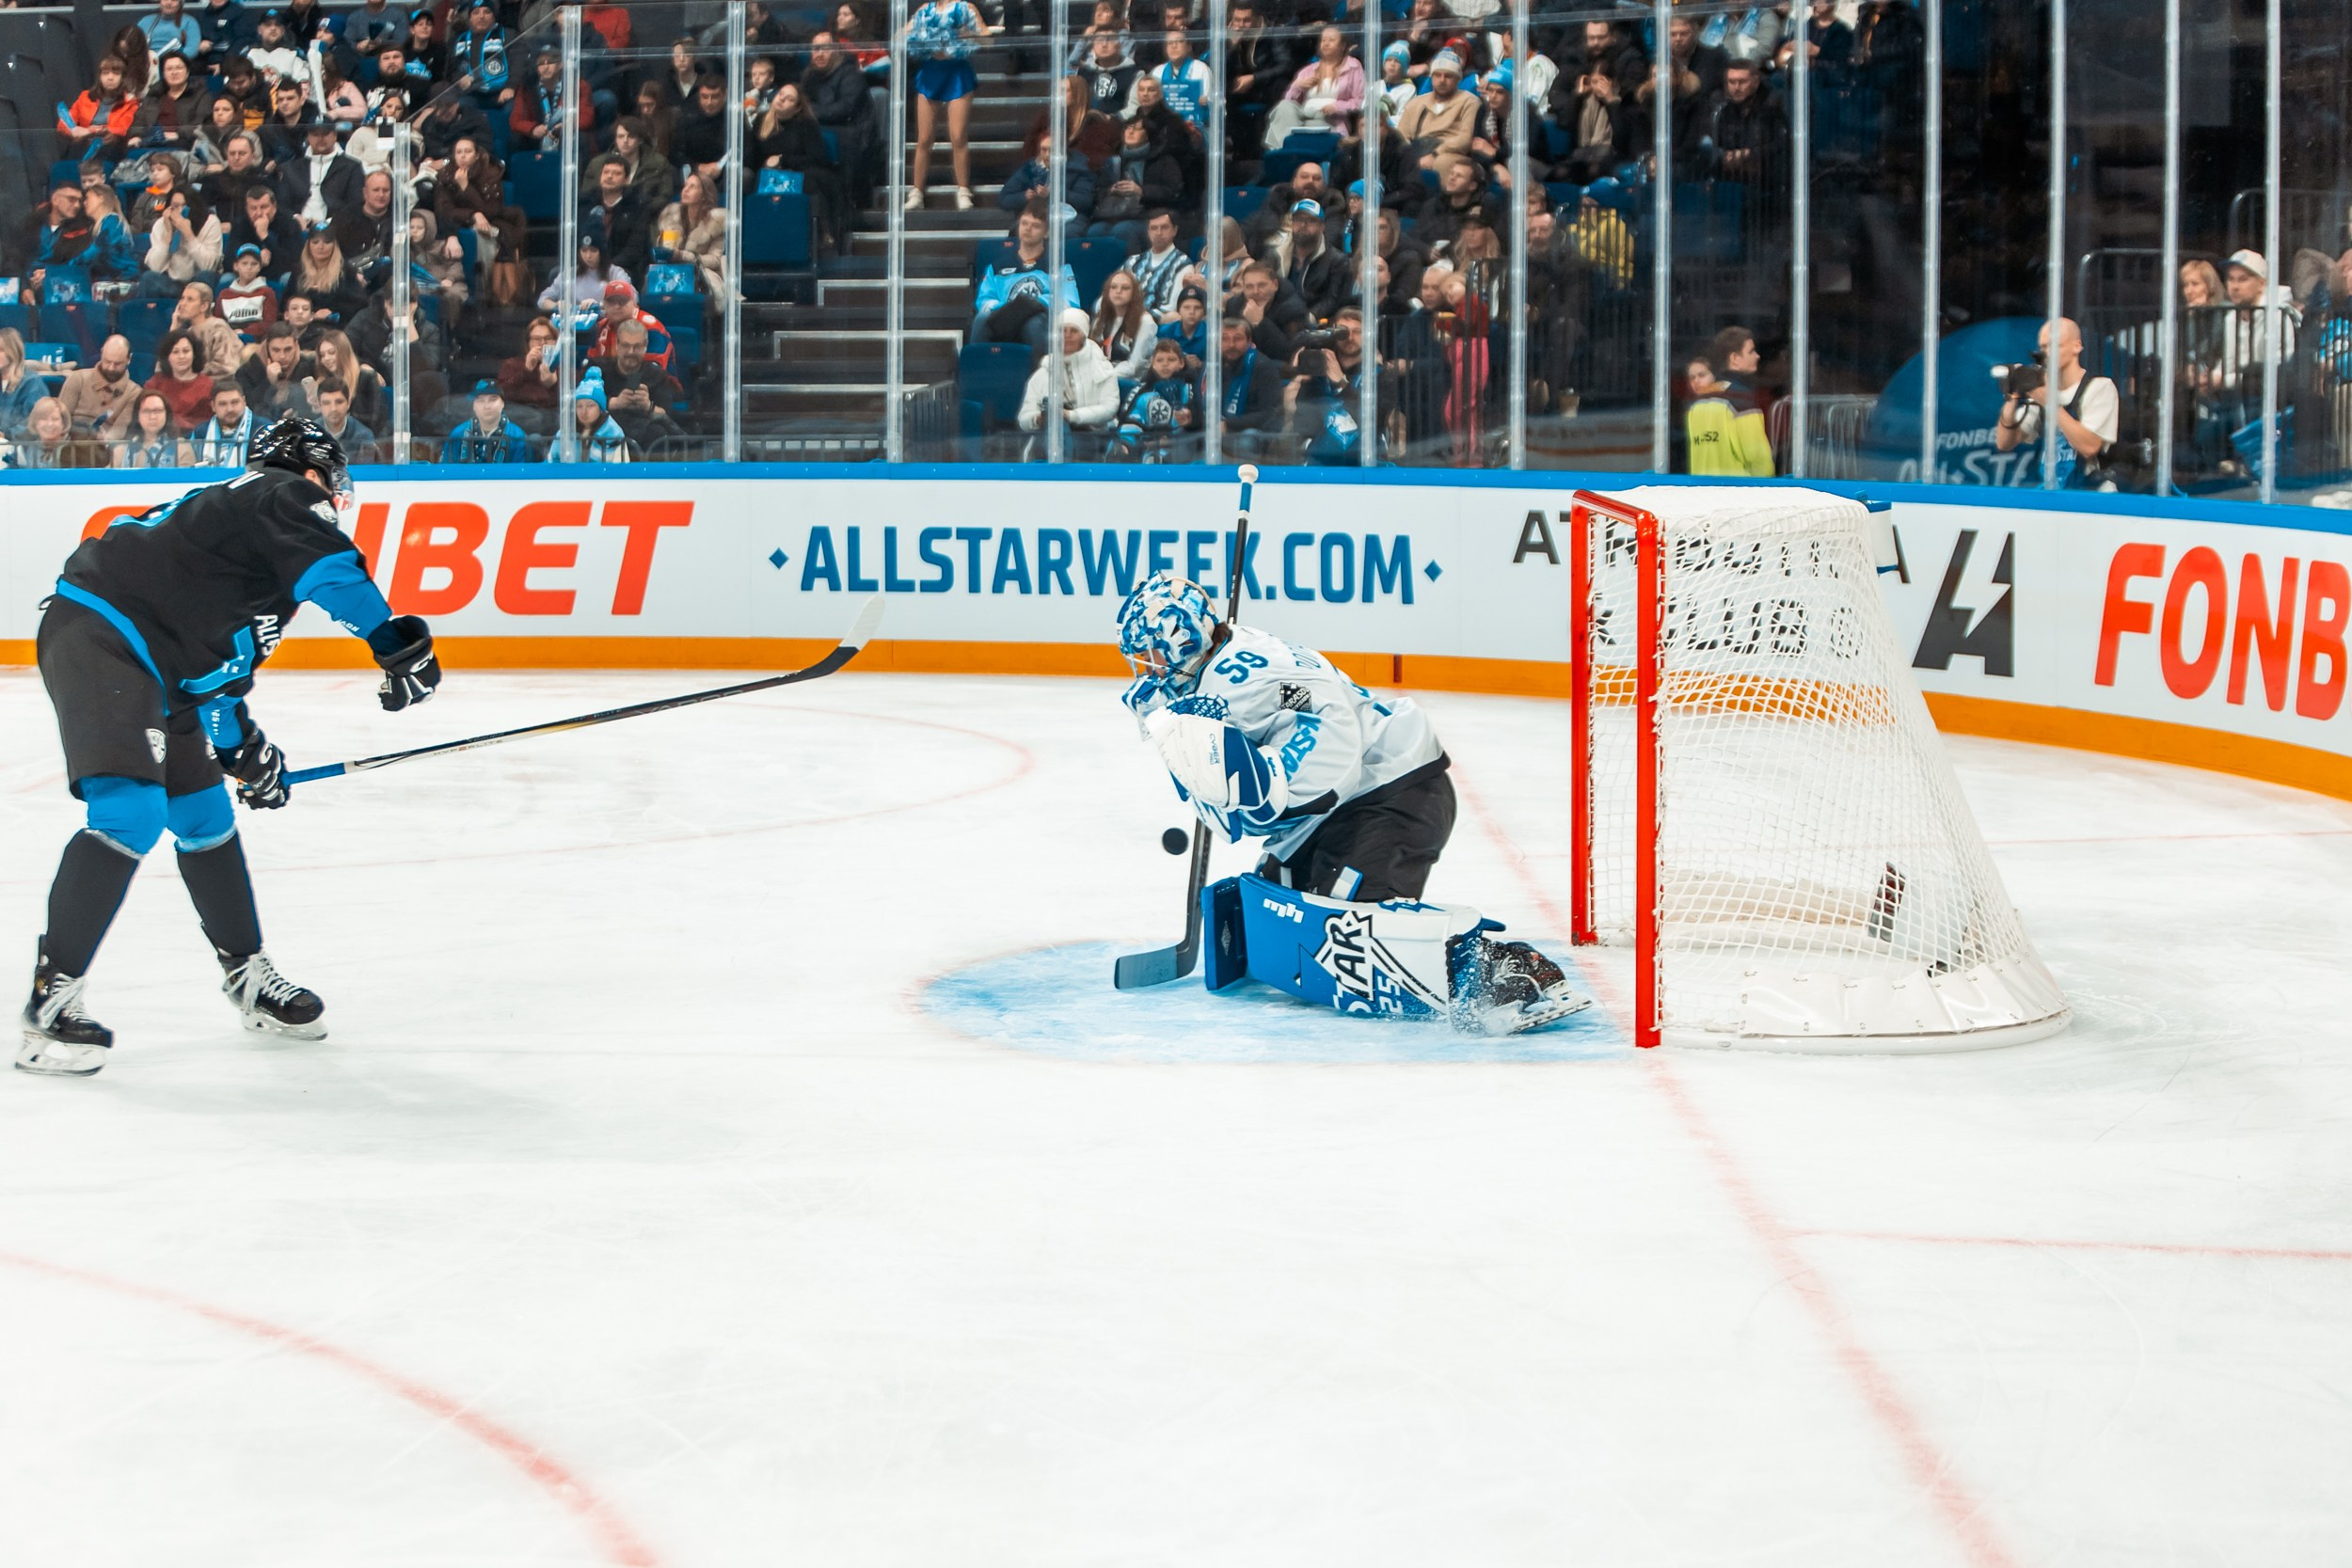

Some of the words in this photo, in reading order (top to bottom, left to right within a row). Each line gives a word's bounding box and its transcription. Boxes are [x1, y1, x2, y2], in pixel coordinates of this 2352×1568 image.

[1936, 428, 1997, 450] FONBE
[801, 525, 1415, 605] ALLSTARWEEK.COM
[1214, 651, 1269, 685] 59
[1280, 688, 1311, 710] TARASO
